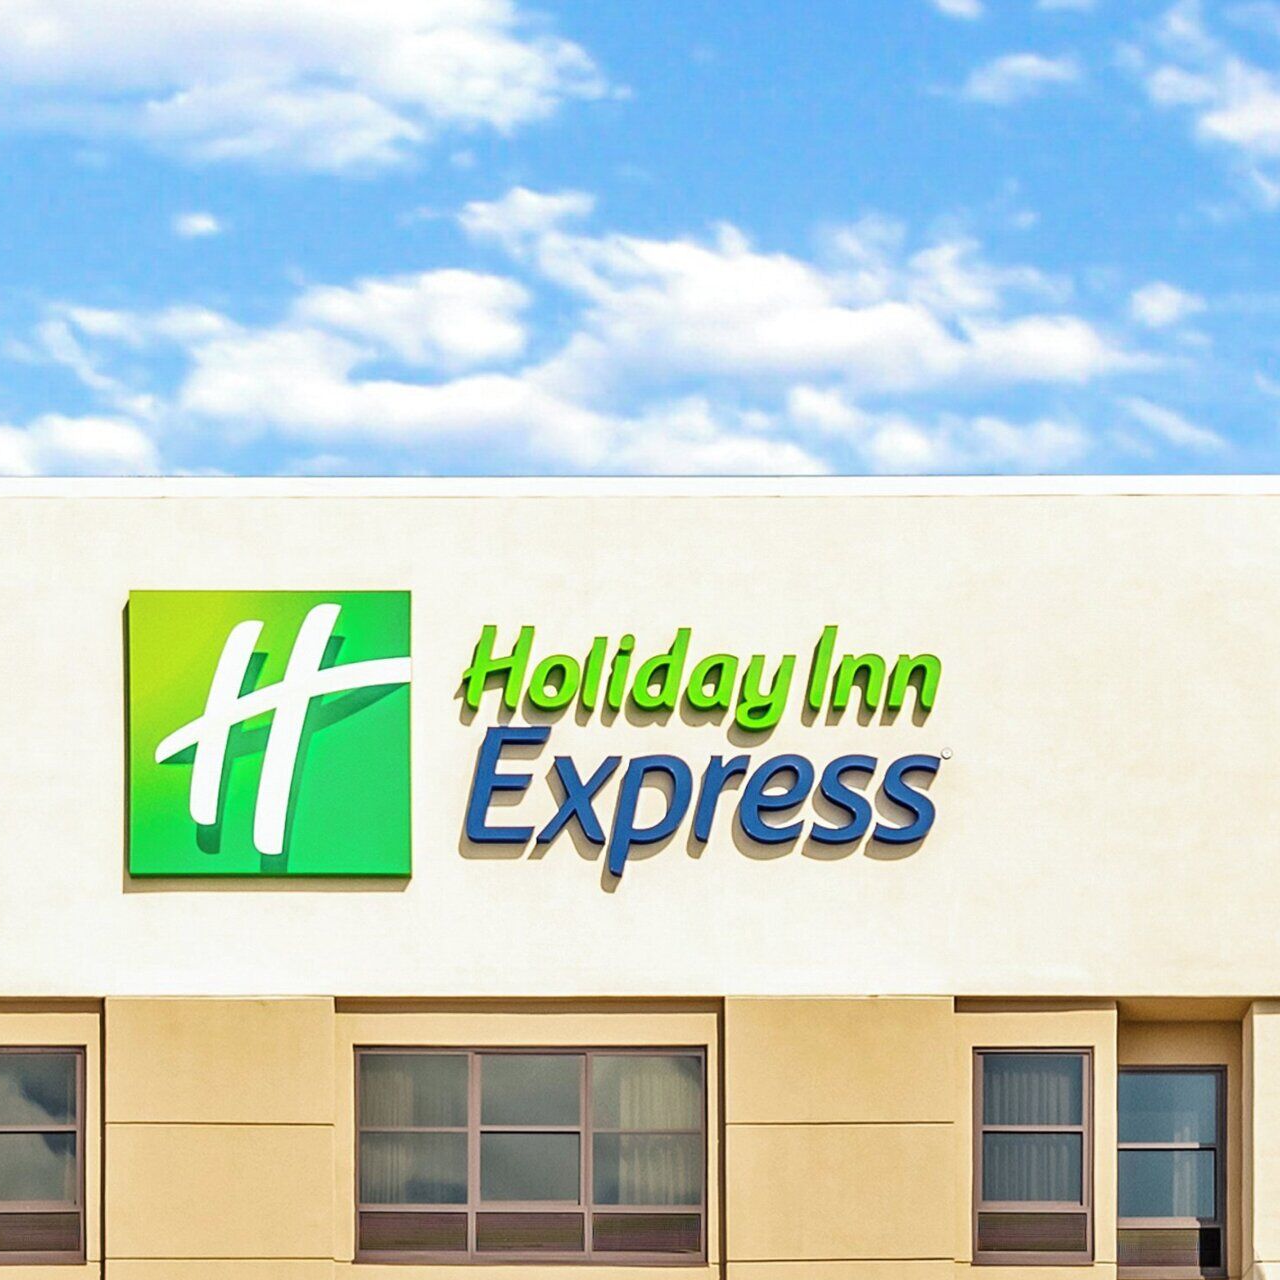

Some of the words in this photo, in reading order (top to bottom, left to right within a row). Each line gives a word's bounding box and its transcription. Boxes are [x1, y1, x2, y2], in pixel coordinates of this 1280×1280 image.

[463, 625, 795, 732] Holiday
[808, 625, 942, 712] Inn
[466, 726, 942, 878] Express
